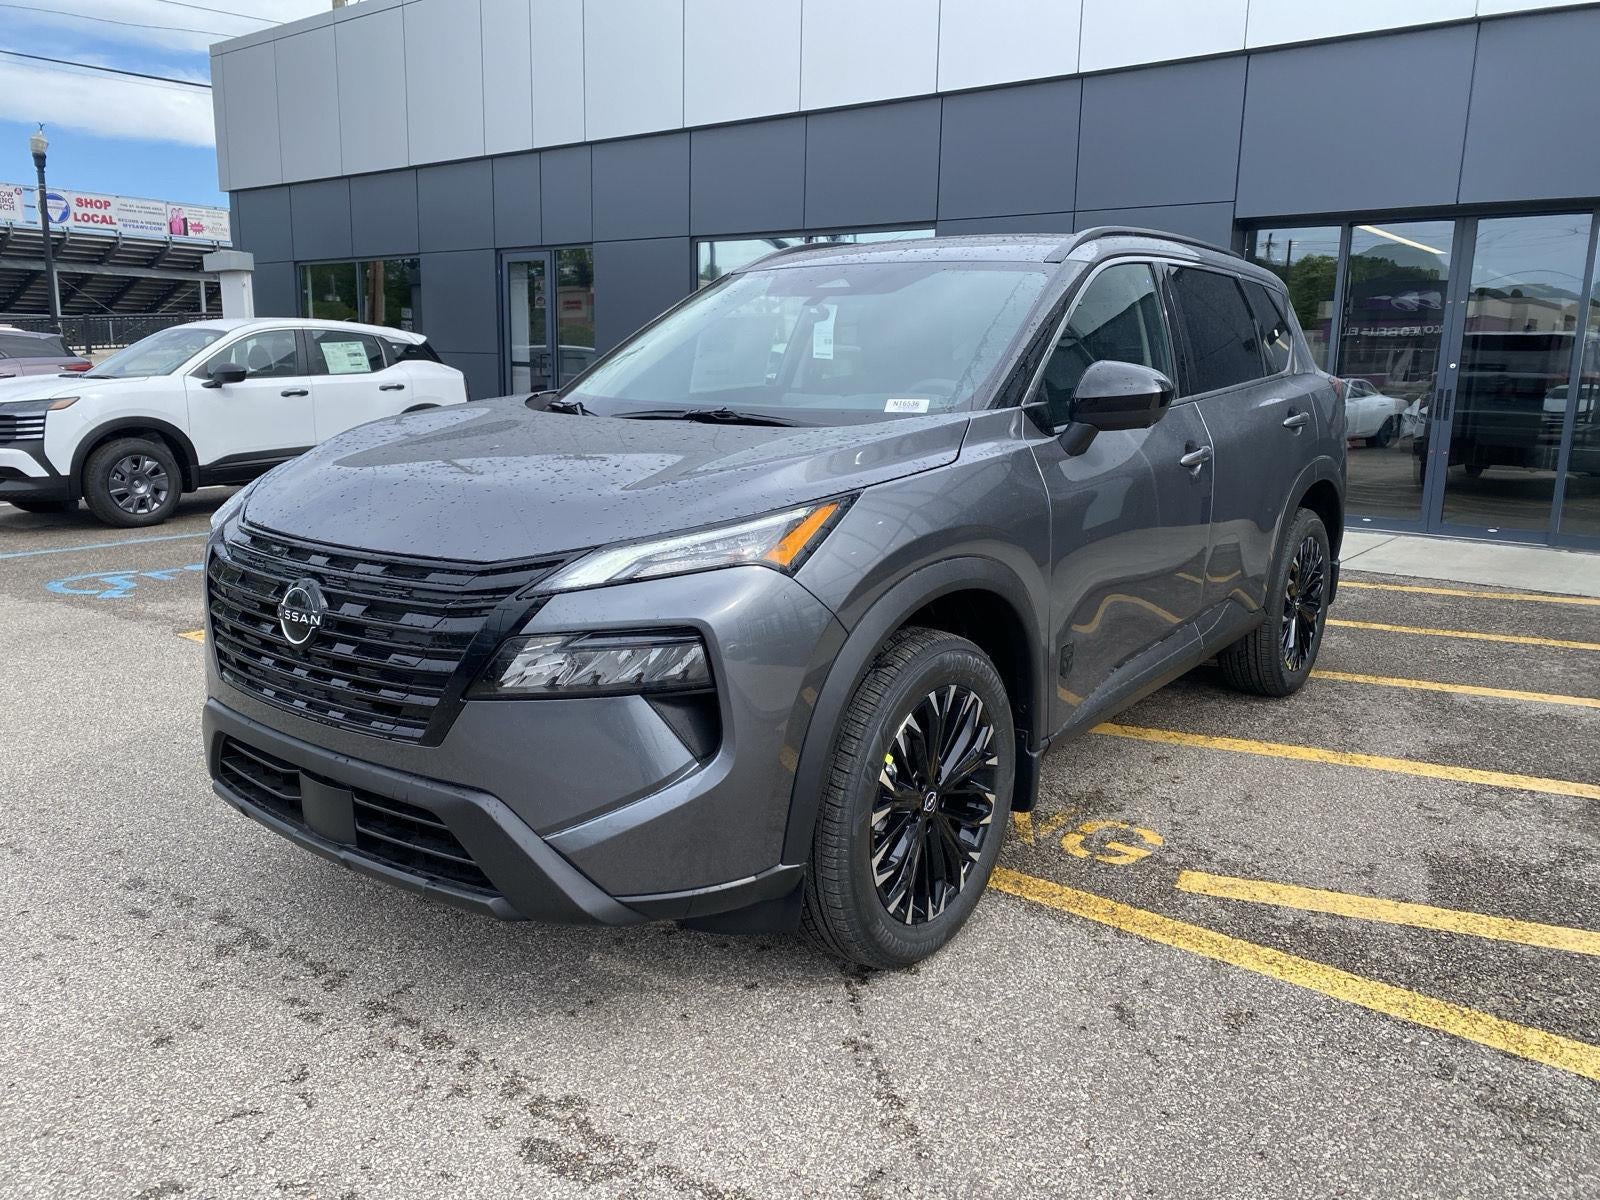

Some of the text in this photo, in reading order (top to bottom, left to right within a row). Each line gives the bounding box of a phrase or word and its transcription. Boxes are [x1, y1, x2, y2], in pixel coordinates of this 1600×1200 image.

[75, 197, 111, 210] SHOP
[73, 212, 117, 226] LOCAL
[280, 610, 321, 625] SSAN
